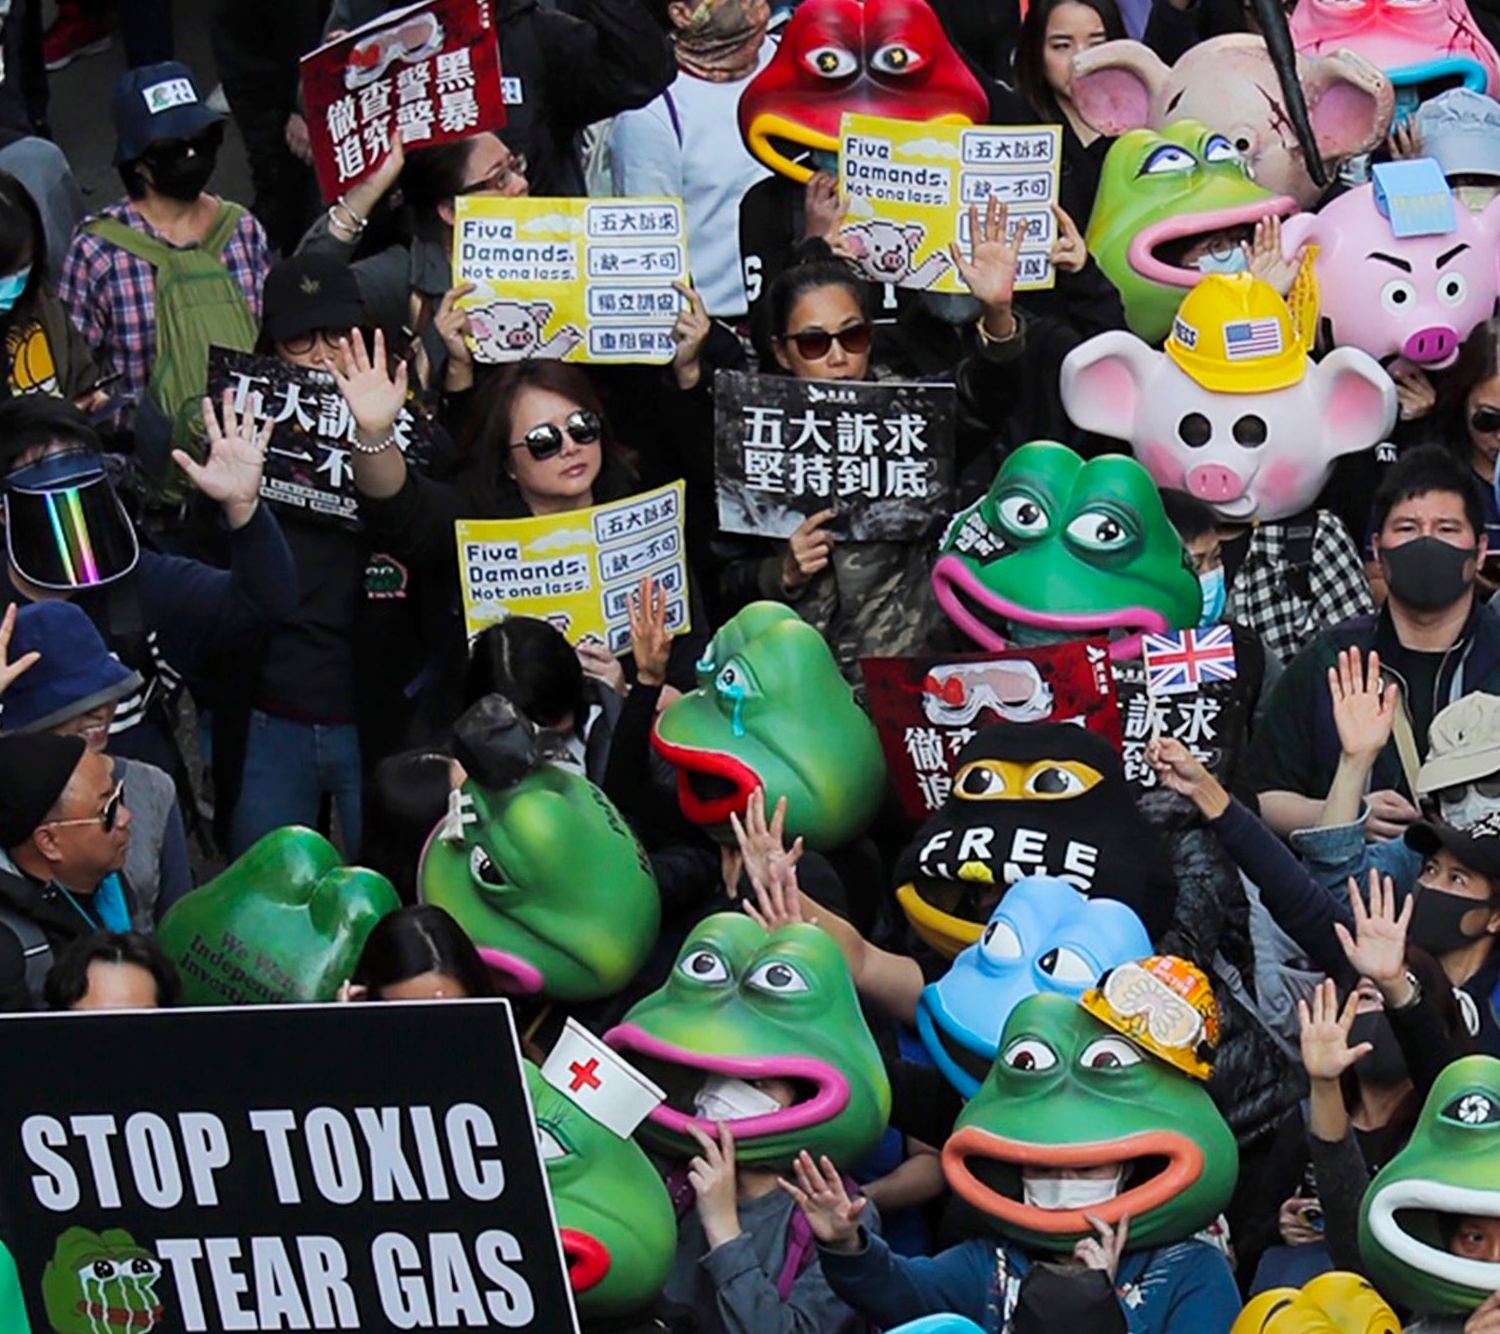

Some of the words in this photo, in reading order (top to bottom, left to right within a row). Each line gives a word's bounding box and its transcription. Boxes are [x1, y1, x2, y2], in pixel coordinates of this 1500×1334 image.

[325, 46, 476, 145] 徹查警黑
[333, 87, 479, 184] 追究警暴
[846, 136, 890, 159] Five
[463, 221, 514, 241] Five
[463, 266, 496, 279] Not
[499, 267, 532, 280] one
[743, 407, 928, 455] 五大訴求
[744, 449, 928, 498] 堅持到底
[468, 544, 519, 563] Five
[471, 587, 505, 602] Not
[510, 583, 542, 598] one
[918, 826, 1100, 878] FREE
[20, 1110, 231, 1214] STOP
[248, 1101, 507, 1207] TOXIC
[155, 1234, 361, 1334] TEAR
[367, 1228, 537, 1331] GAS
